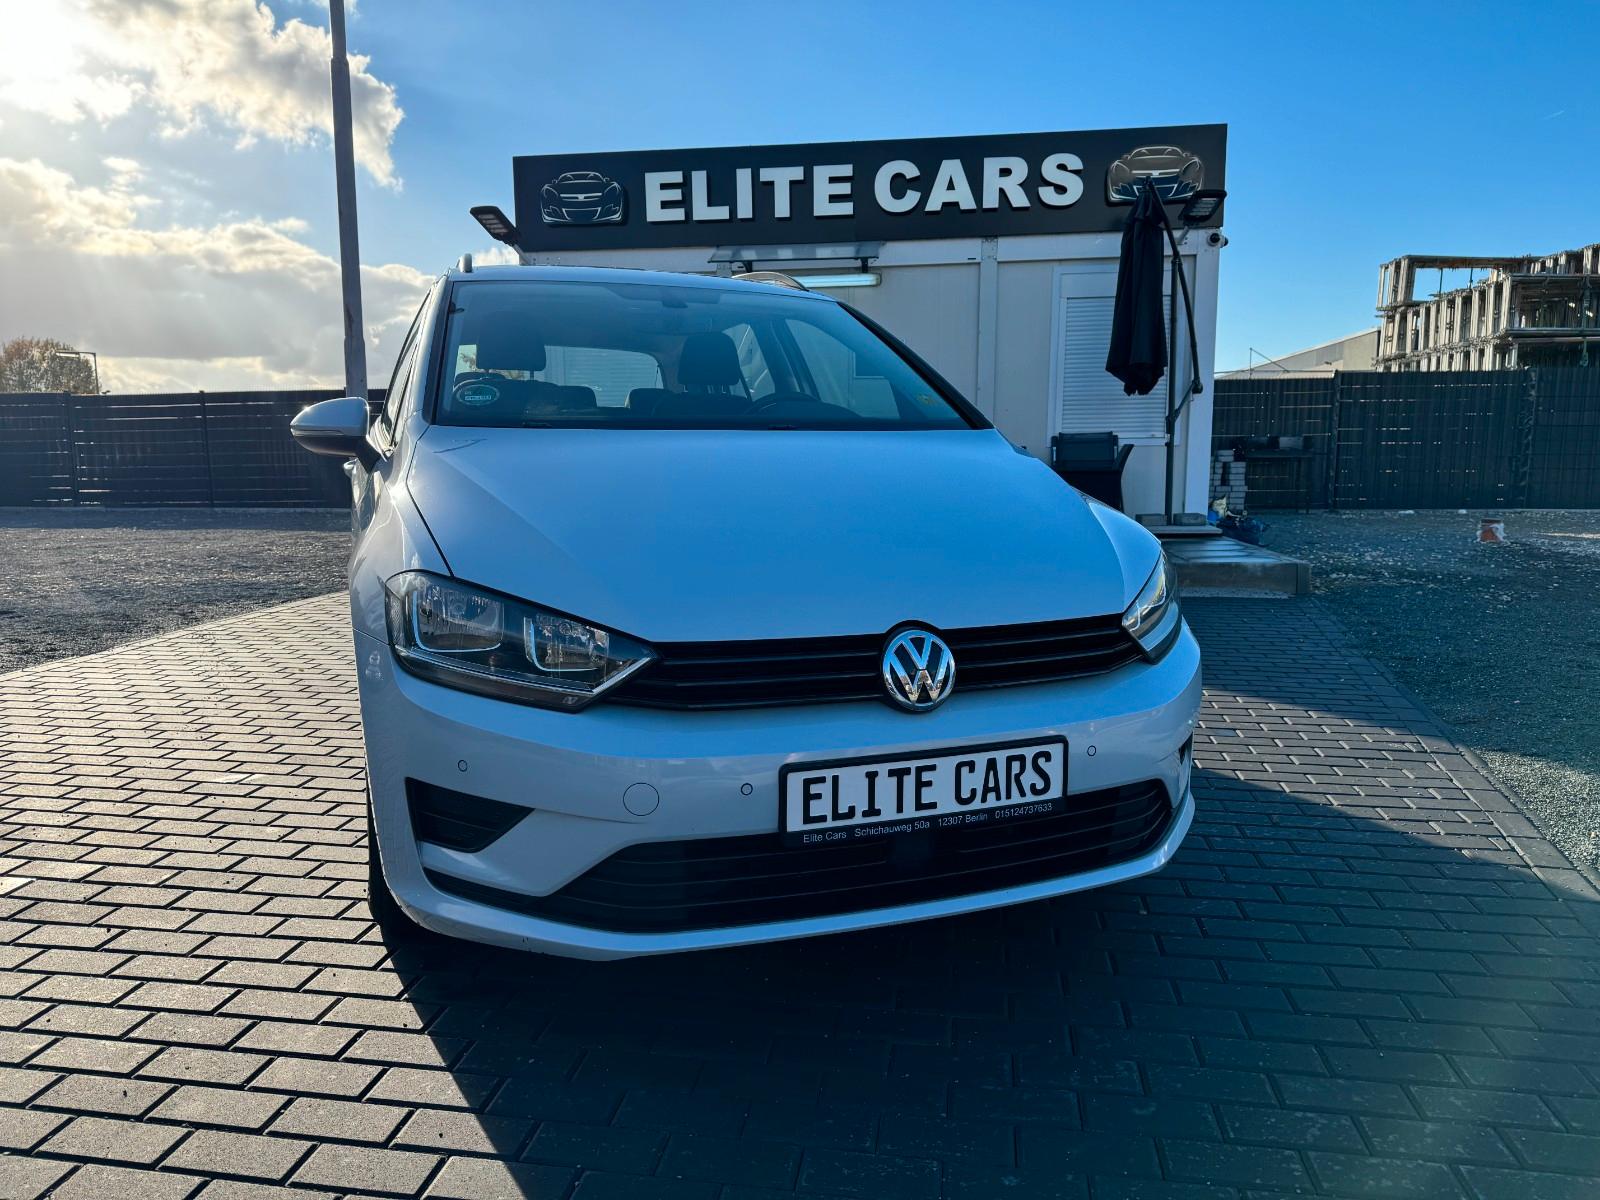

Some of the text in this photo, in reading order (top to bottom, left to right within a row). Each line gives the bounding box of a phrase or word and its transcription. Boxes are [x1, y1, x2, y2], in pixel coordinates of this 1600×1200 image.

[644, 152, 1084, 223] ELITE CARS
[884, 630, 956, 711] VW
[802, 750, 1053, 825] ELITE CARS
[803, 832, 823, 844] Elite
[825, 830, 847, 842] Cars
[854, 822, 912, 838] Schichauweg
[914, 820, 930, 831] 50a
[938, 815, 963, 827] 12307
[965, 812, 988, 824] Berlin
